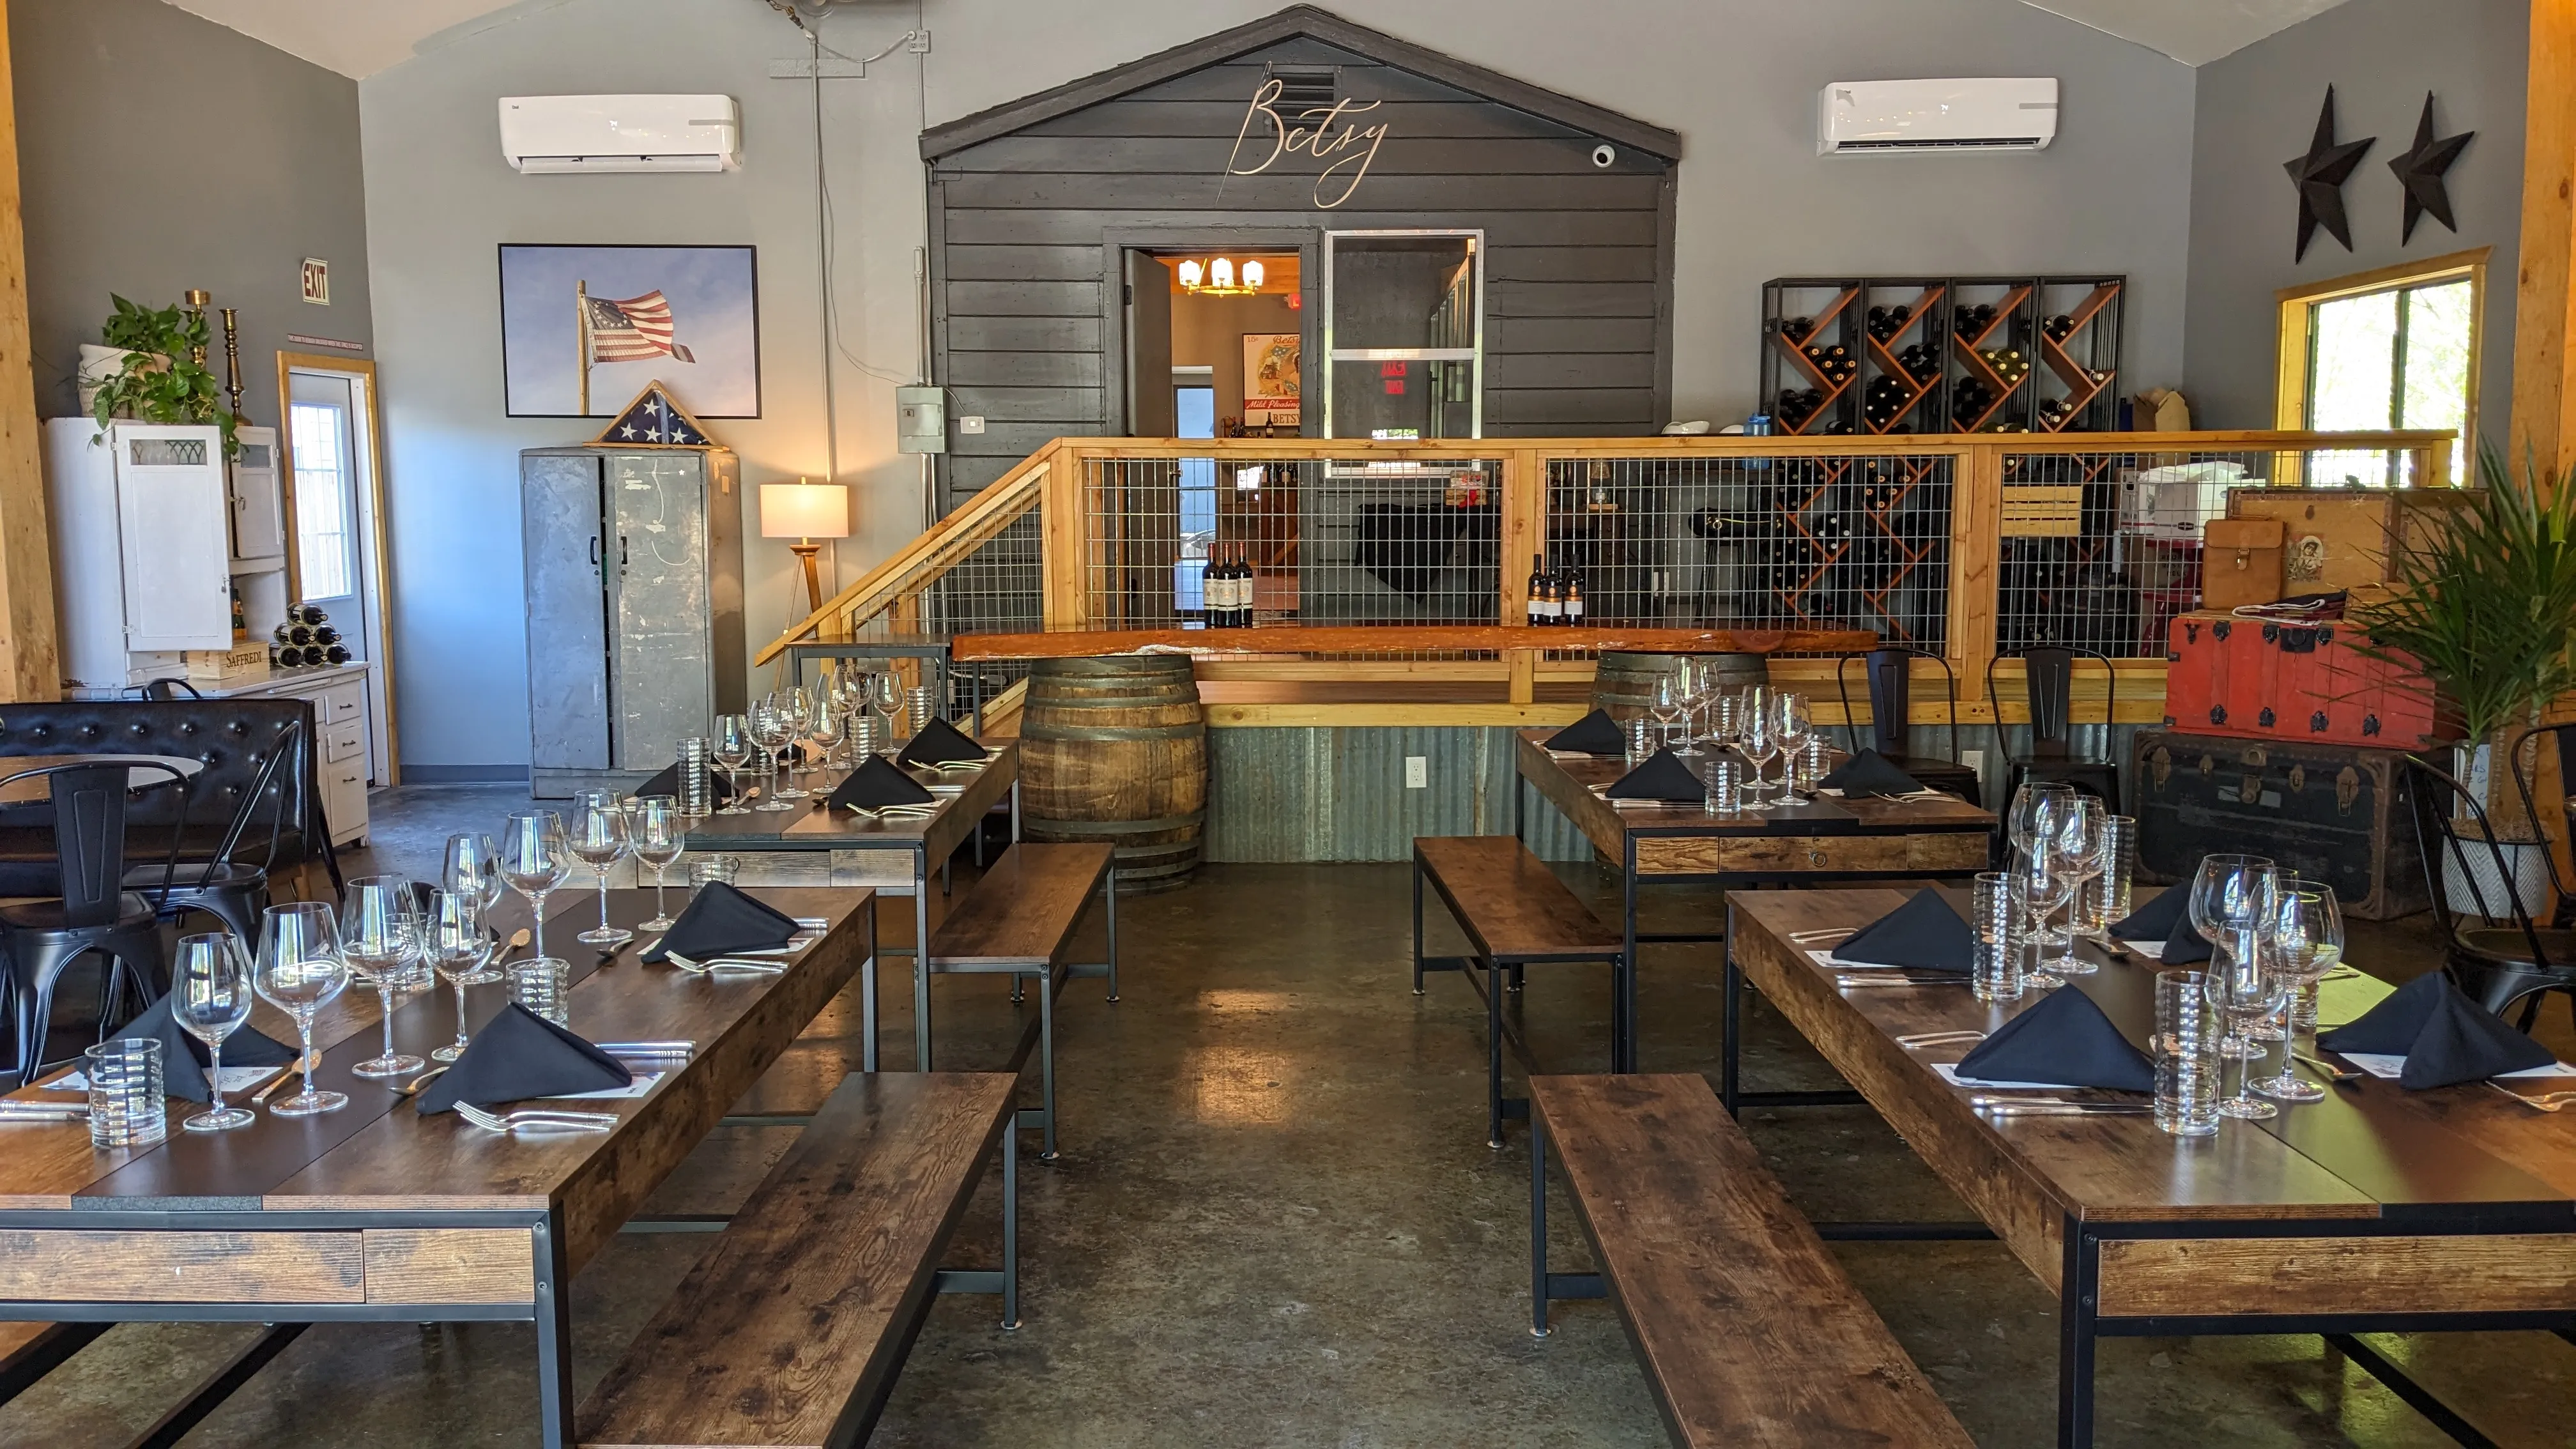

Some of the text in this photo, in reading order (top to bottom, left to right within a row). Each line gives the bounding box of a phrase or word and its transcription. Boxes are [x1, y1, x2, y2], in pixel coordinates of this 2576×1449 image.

[1216, 61, 1388, 208] Betsy
[303, 263, 326, 299] EXIT
[1246, 399, 1300, 410] Mild Pleasing
[226, 651, 262, 668] SAFFREDI
